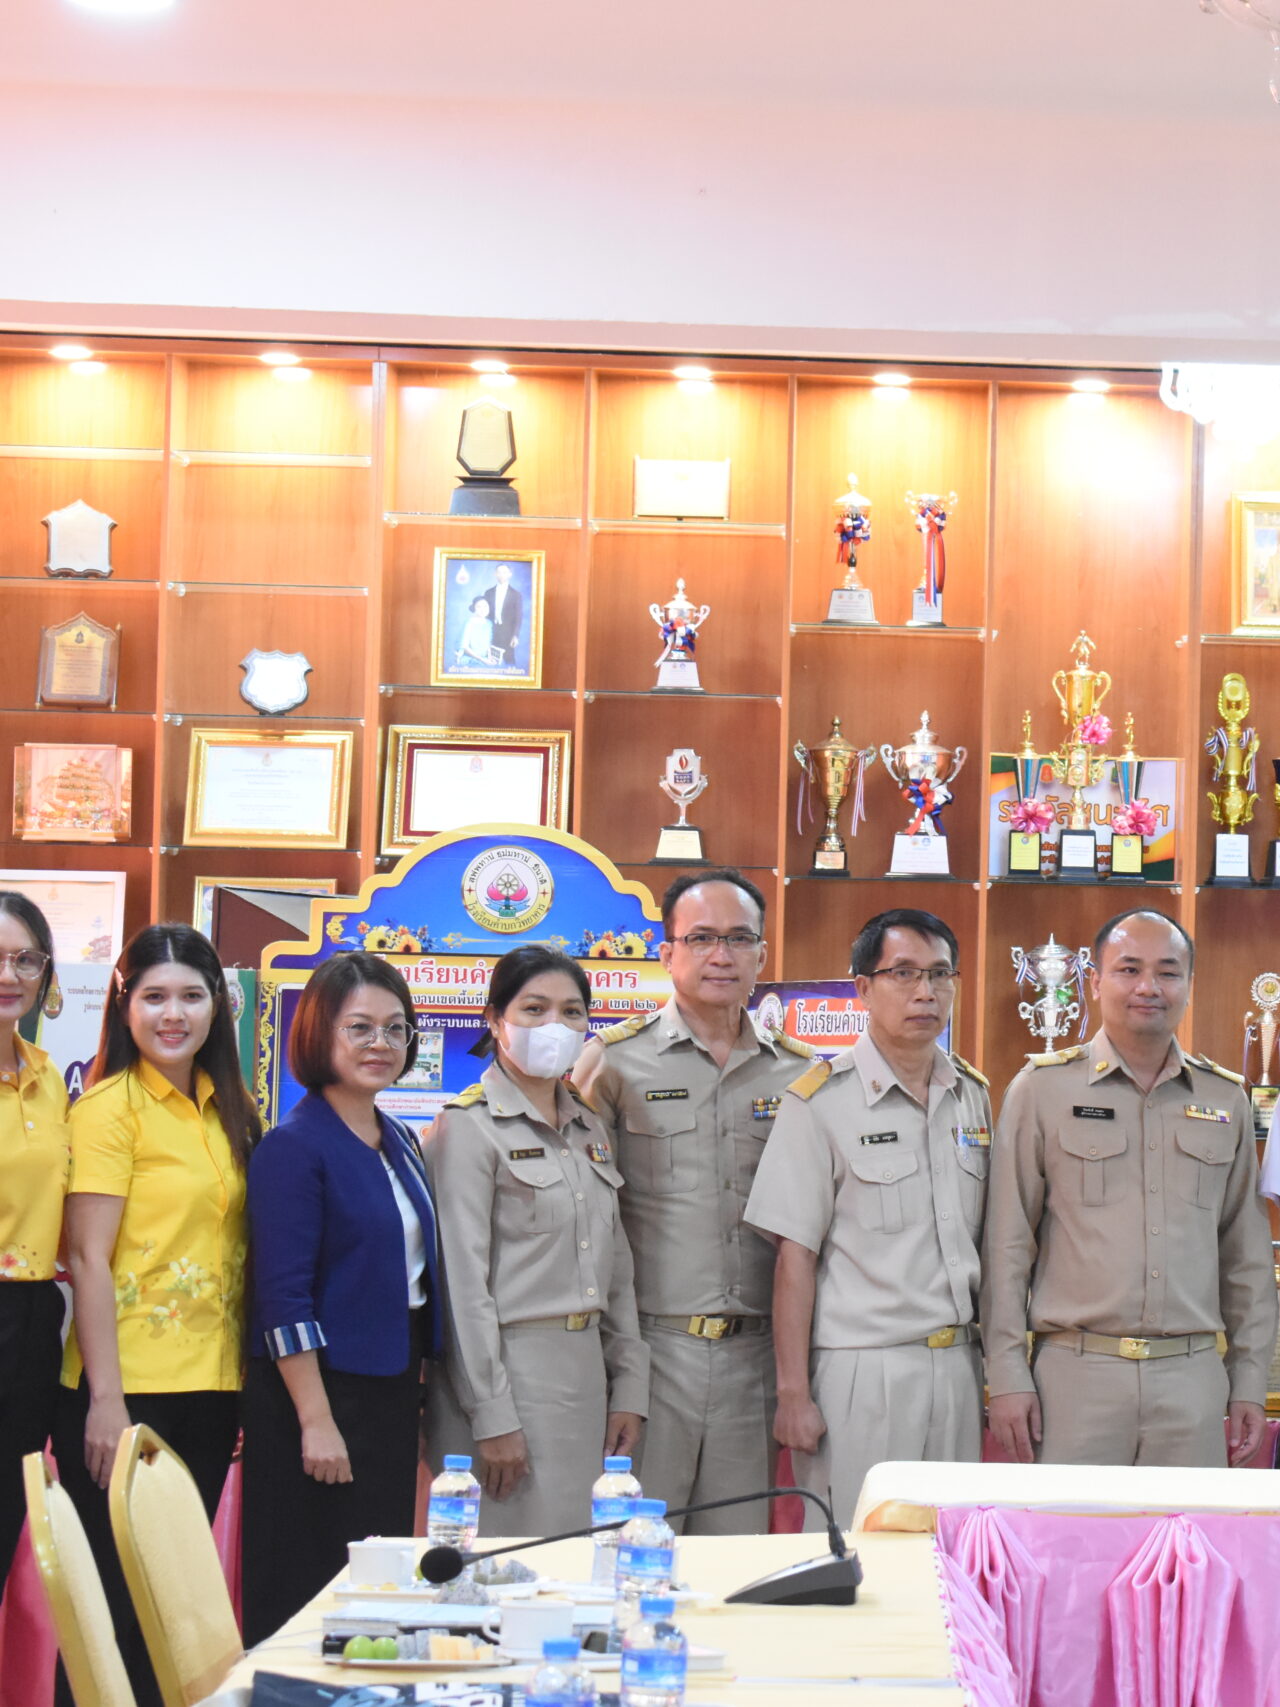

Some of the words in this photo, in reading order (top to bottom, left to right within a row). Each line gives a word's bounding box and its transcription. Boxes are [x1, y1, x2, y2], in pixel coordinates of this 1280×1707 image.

[609, 1000, 630, 1009] เขต
[635, 1000, 657, 1009] ๒๒
[68, 1065, 84, 1094] A
